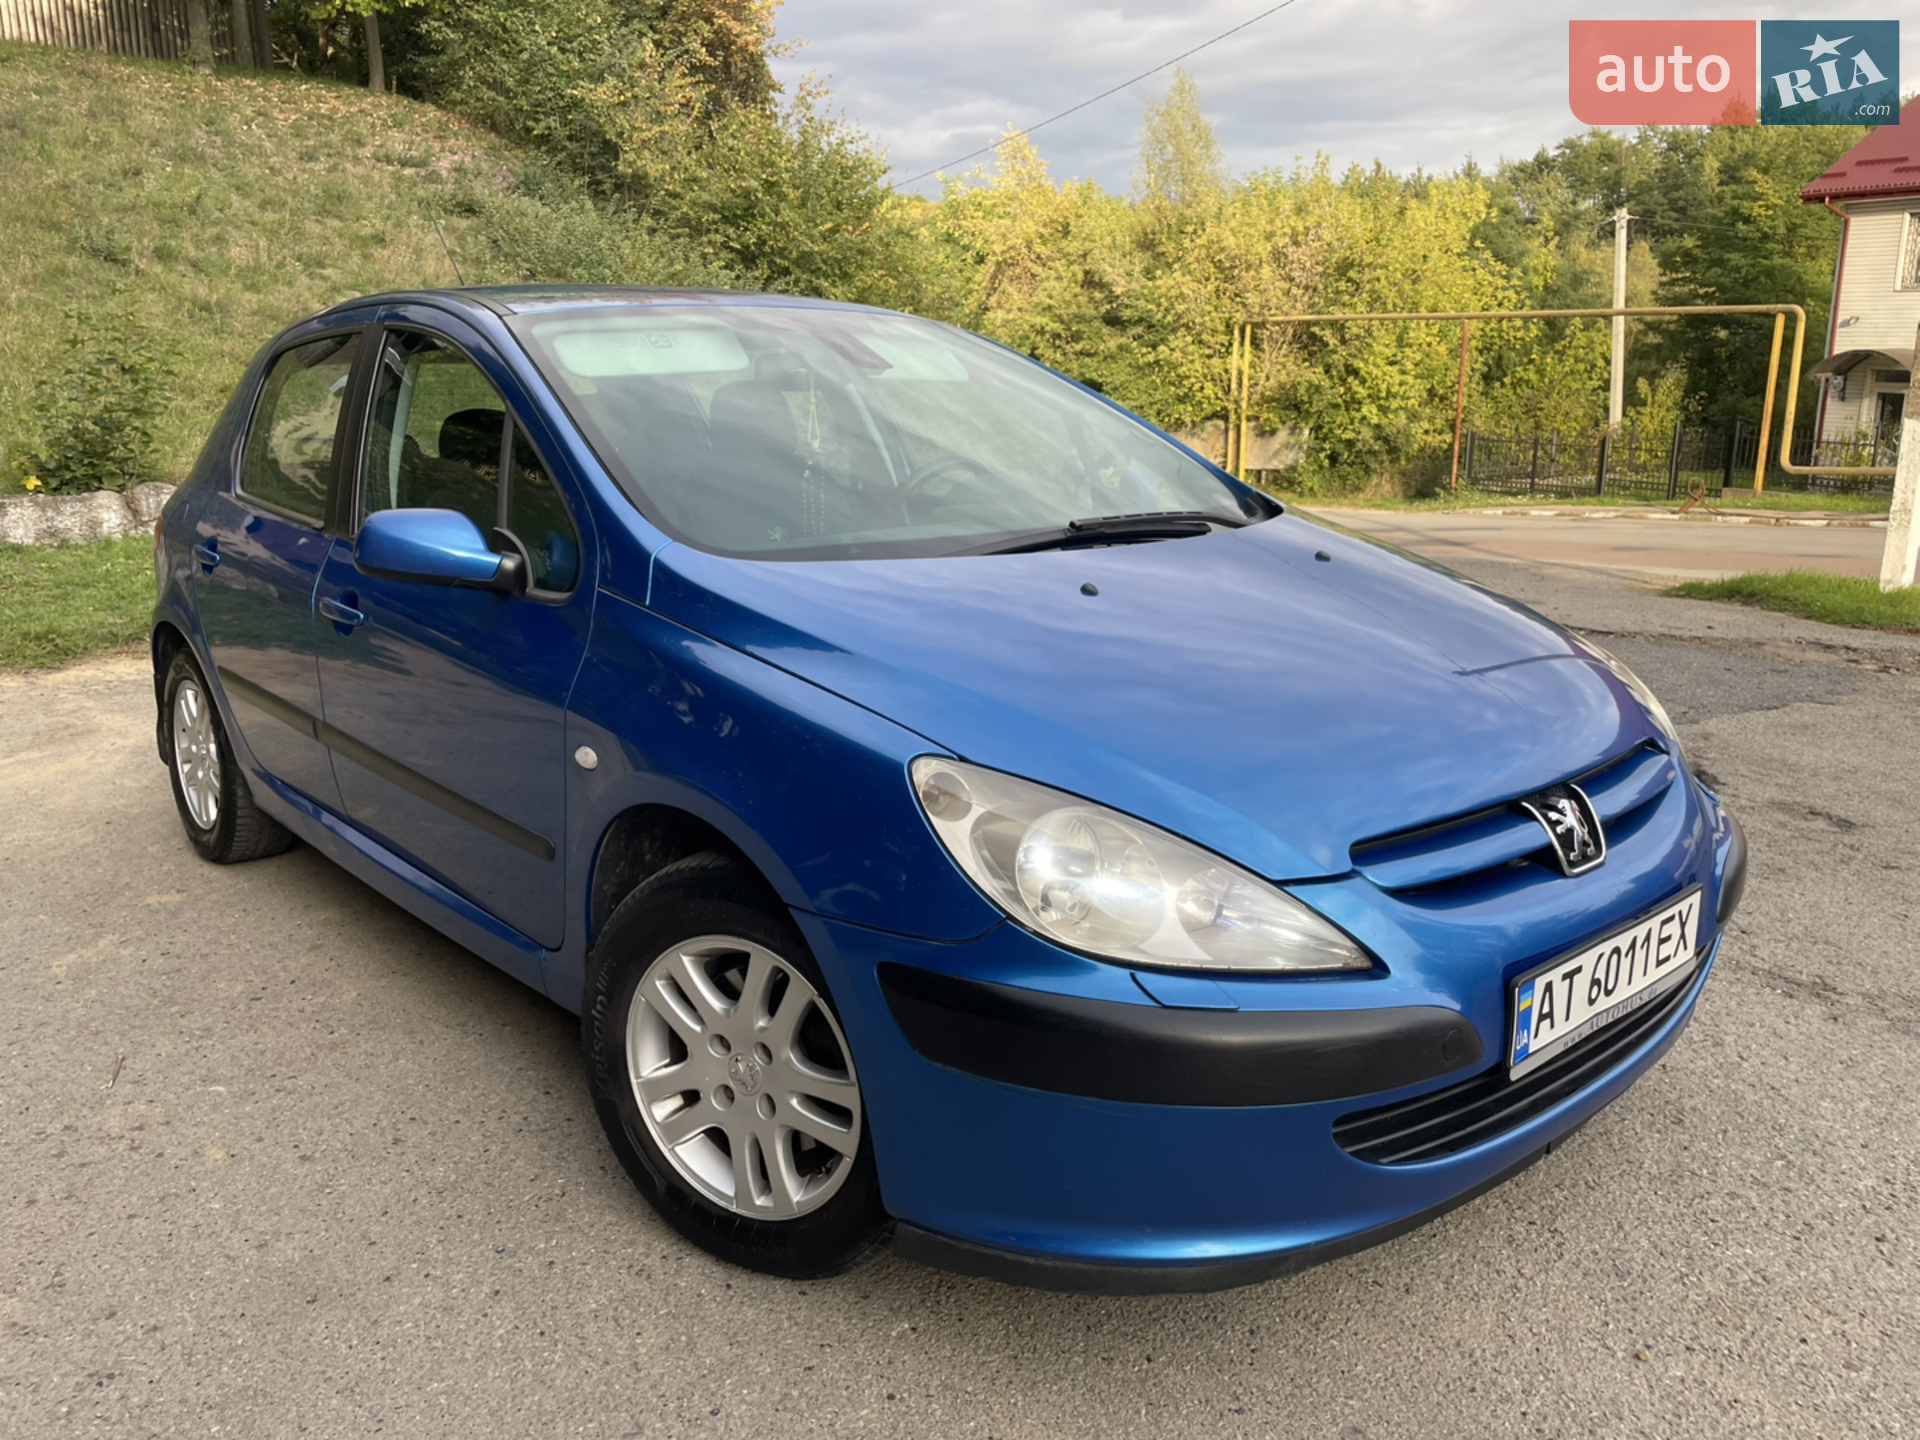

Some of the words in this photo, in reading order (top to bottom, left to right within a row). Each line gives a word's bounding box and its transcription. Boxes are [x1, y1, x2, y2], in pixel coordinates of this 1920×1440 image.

[1533, 980, 1583, 1039] AT
[1587, 927, 1652, 1007] 6011
[1655, 902, 1693, 969] EX
[1516, 1028, 1528, 1050] UA
